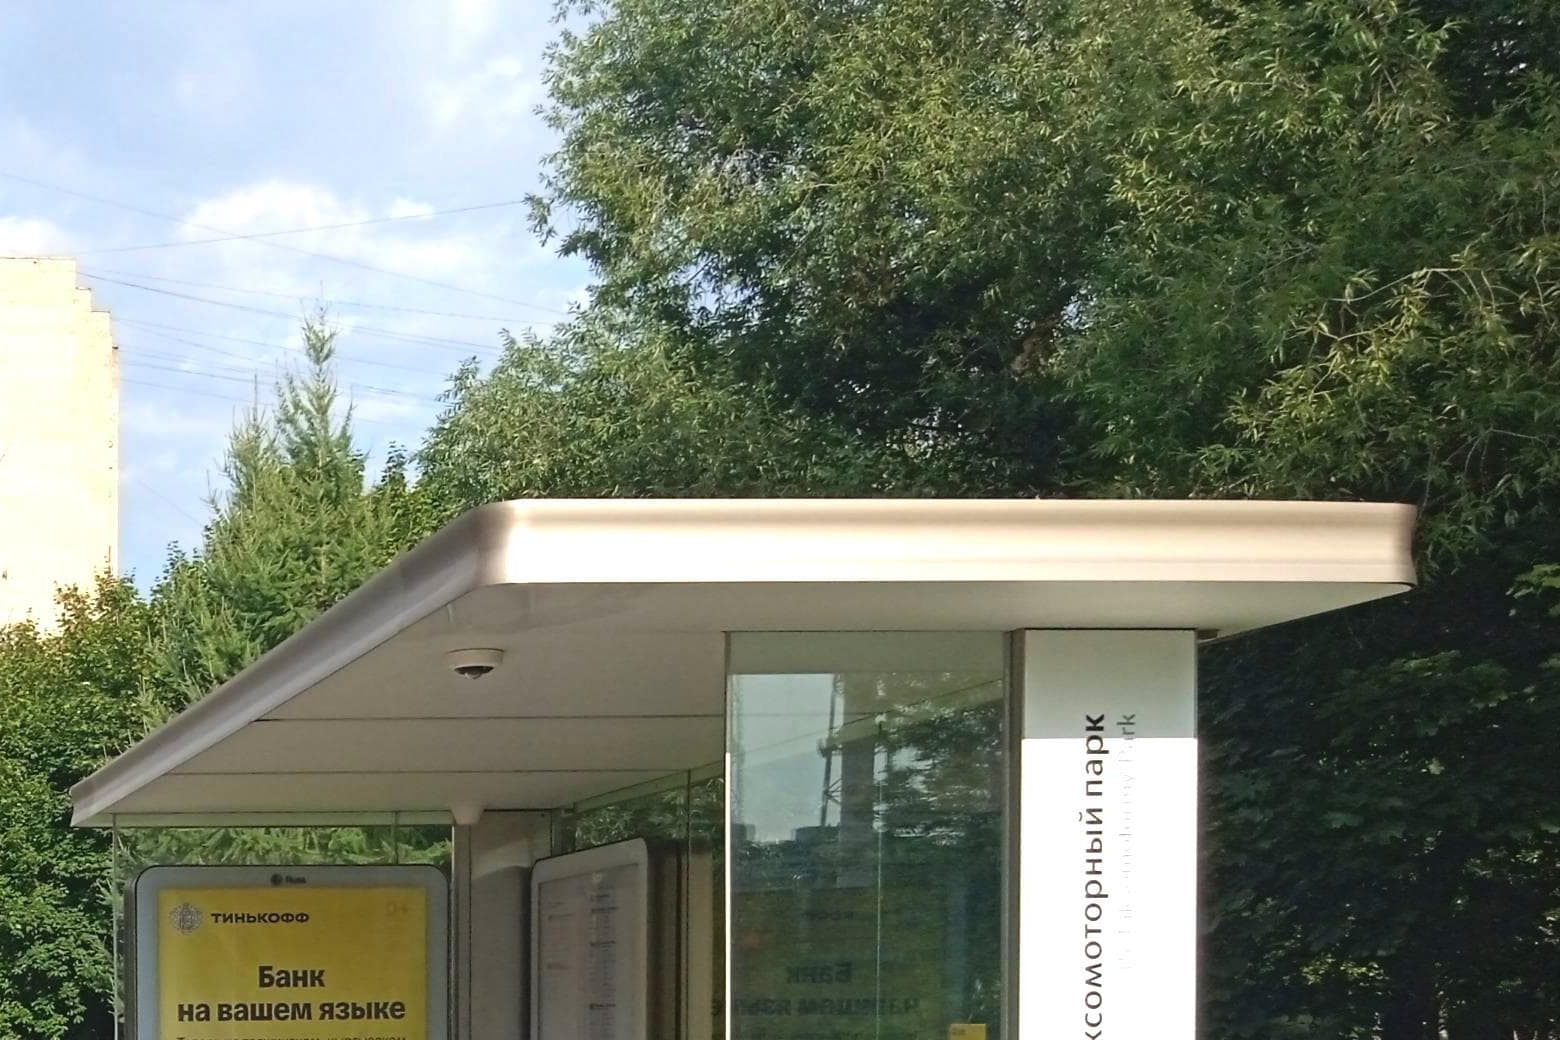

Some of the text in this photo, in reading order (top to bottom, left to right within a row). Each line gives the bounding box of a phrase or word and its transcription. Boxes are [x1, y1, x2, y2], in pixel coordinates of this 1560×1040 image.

[1084, 712, 1110, 797] парк
[210, 912, 310, 924] ТИНЬКОФФ
[258, 964, 326, 989] Банк
[177, 1001, 406, 1023] на вашем языке
